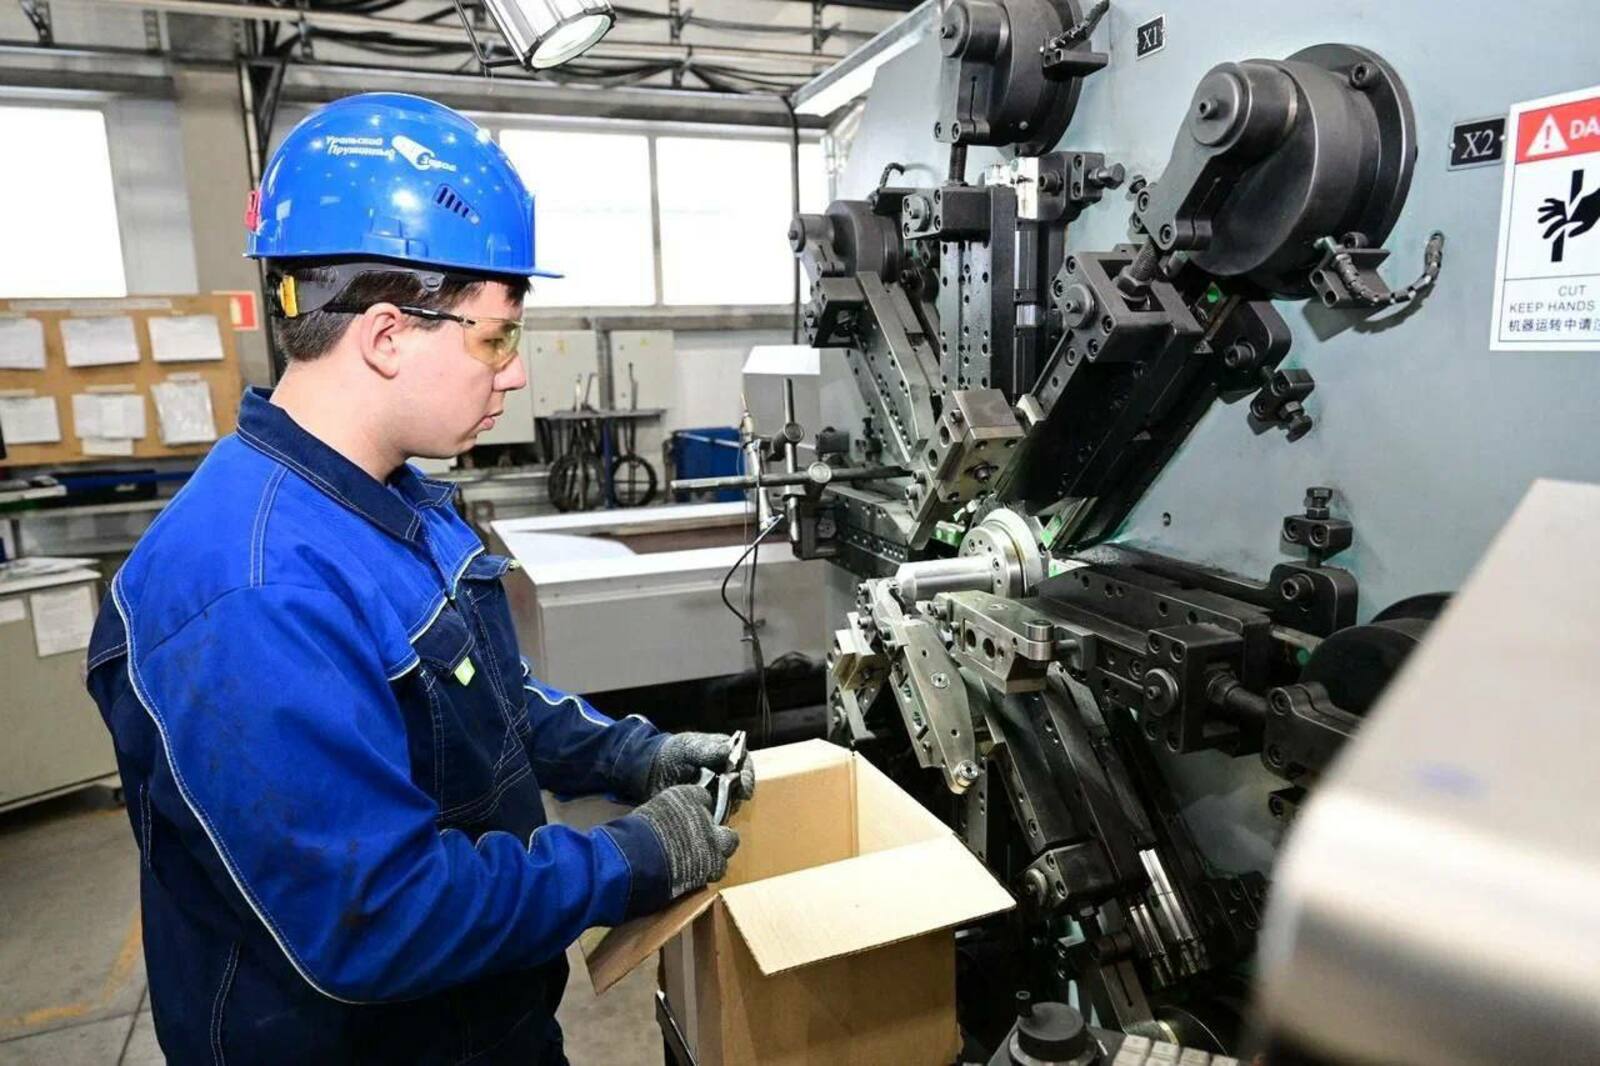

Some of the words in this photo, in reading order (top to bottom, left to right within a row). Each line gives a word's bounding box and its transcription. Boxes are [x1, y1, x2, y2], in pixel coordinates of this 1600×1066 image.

[1460, 129, 1494, 159] X2
[1558, 284, 1587, 297] CUT
[1509, 301, 1544, 313] KEEP
[1547, 300, 1596, 312] HANDS
